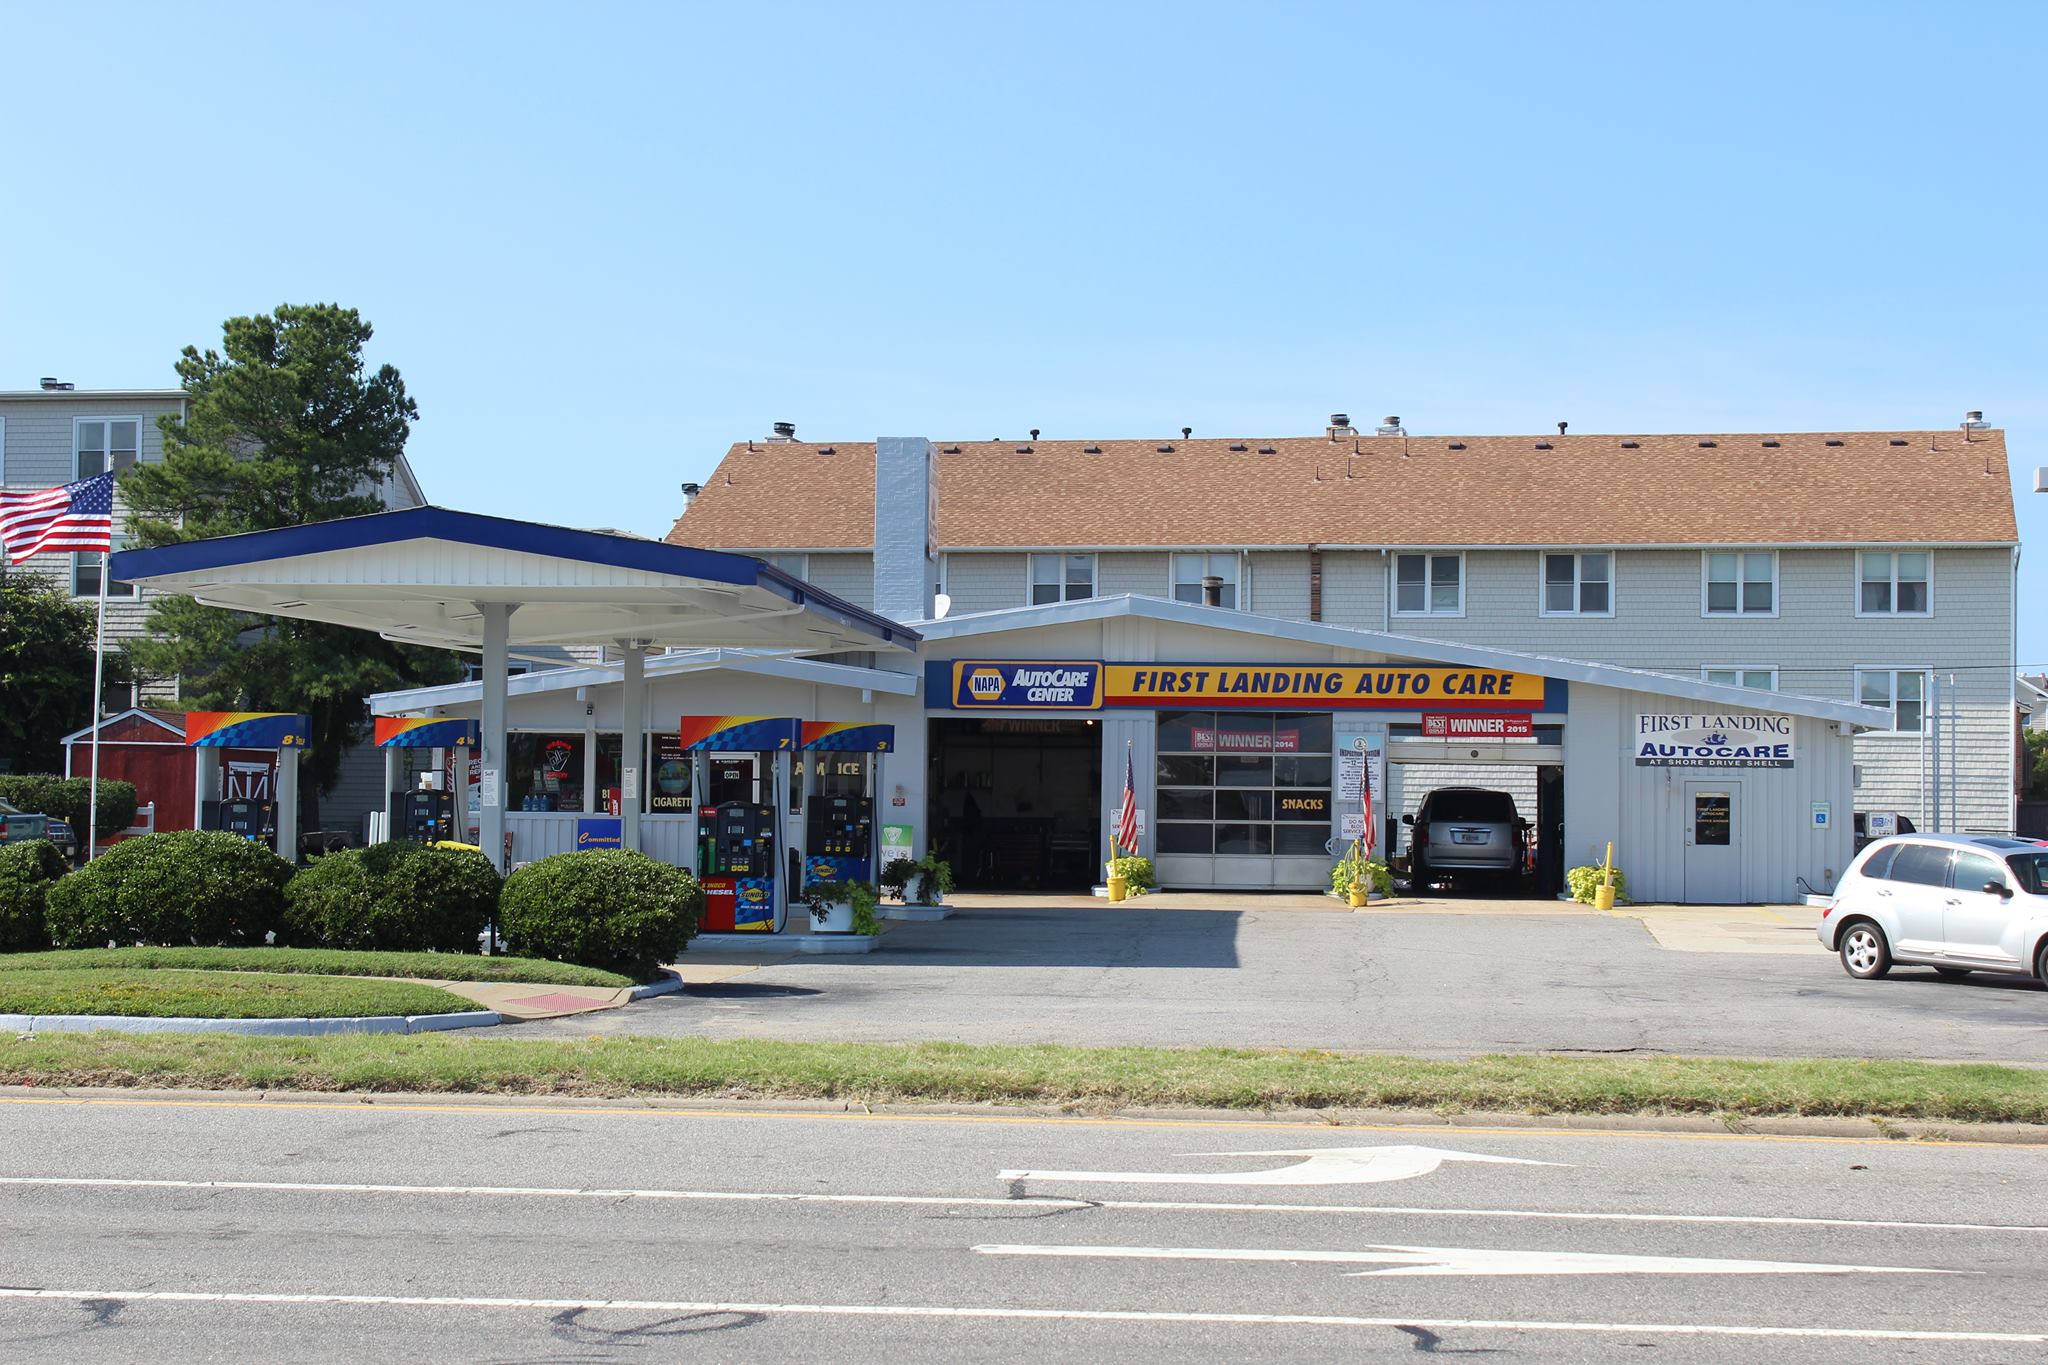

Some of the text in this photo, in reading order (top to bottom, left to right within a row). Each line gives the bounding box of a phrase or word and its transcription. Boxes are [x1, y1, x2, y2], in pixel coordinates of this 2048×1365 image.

[974, 677, 1000, 692] NAPA
[1132, 671, 1514, 695] FIRST LANDING AUTO CARE
[1027, 688, 1075, 702] CENTER
[1428, 719, 1445, 728] BEST
[1450, 719, 1504, 733] WINNER
[1639, 715, 1790, 735] FIRST LANDING
[282, 735, 294, 745] 8
[456, 737, 465, 746] 4
[779, 738, 790, 748] 7
[877, 741, 887, 750] 3
[1196, 733, 1214, 742] BEST
[1218, 735, 1272, 748] WINNER
[1640, 742, 1790, 758] AUTOCARE
[837, 762, 860, 775] ICE
[653, 797, 692, 807] CIGARETT
[1282, 799, 1323, 810] SNACKS
[578, 832, 621, 844] Committed
[740, 891, 770, 899] SUNOCO
